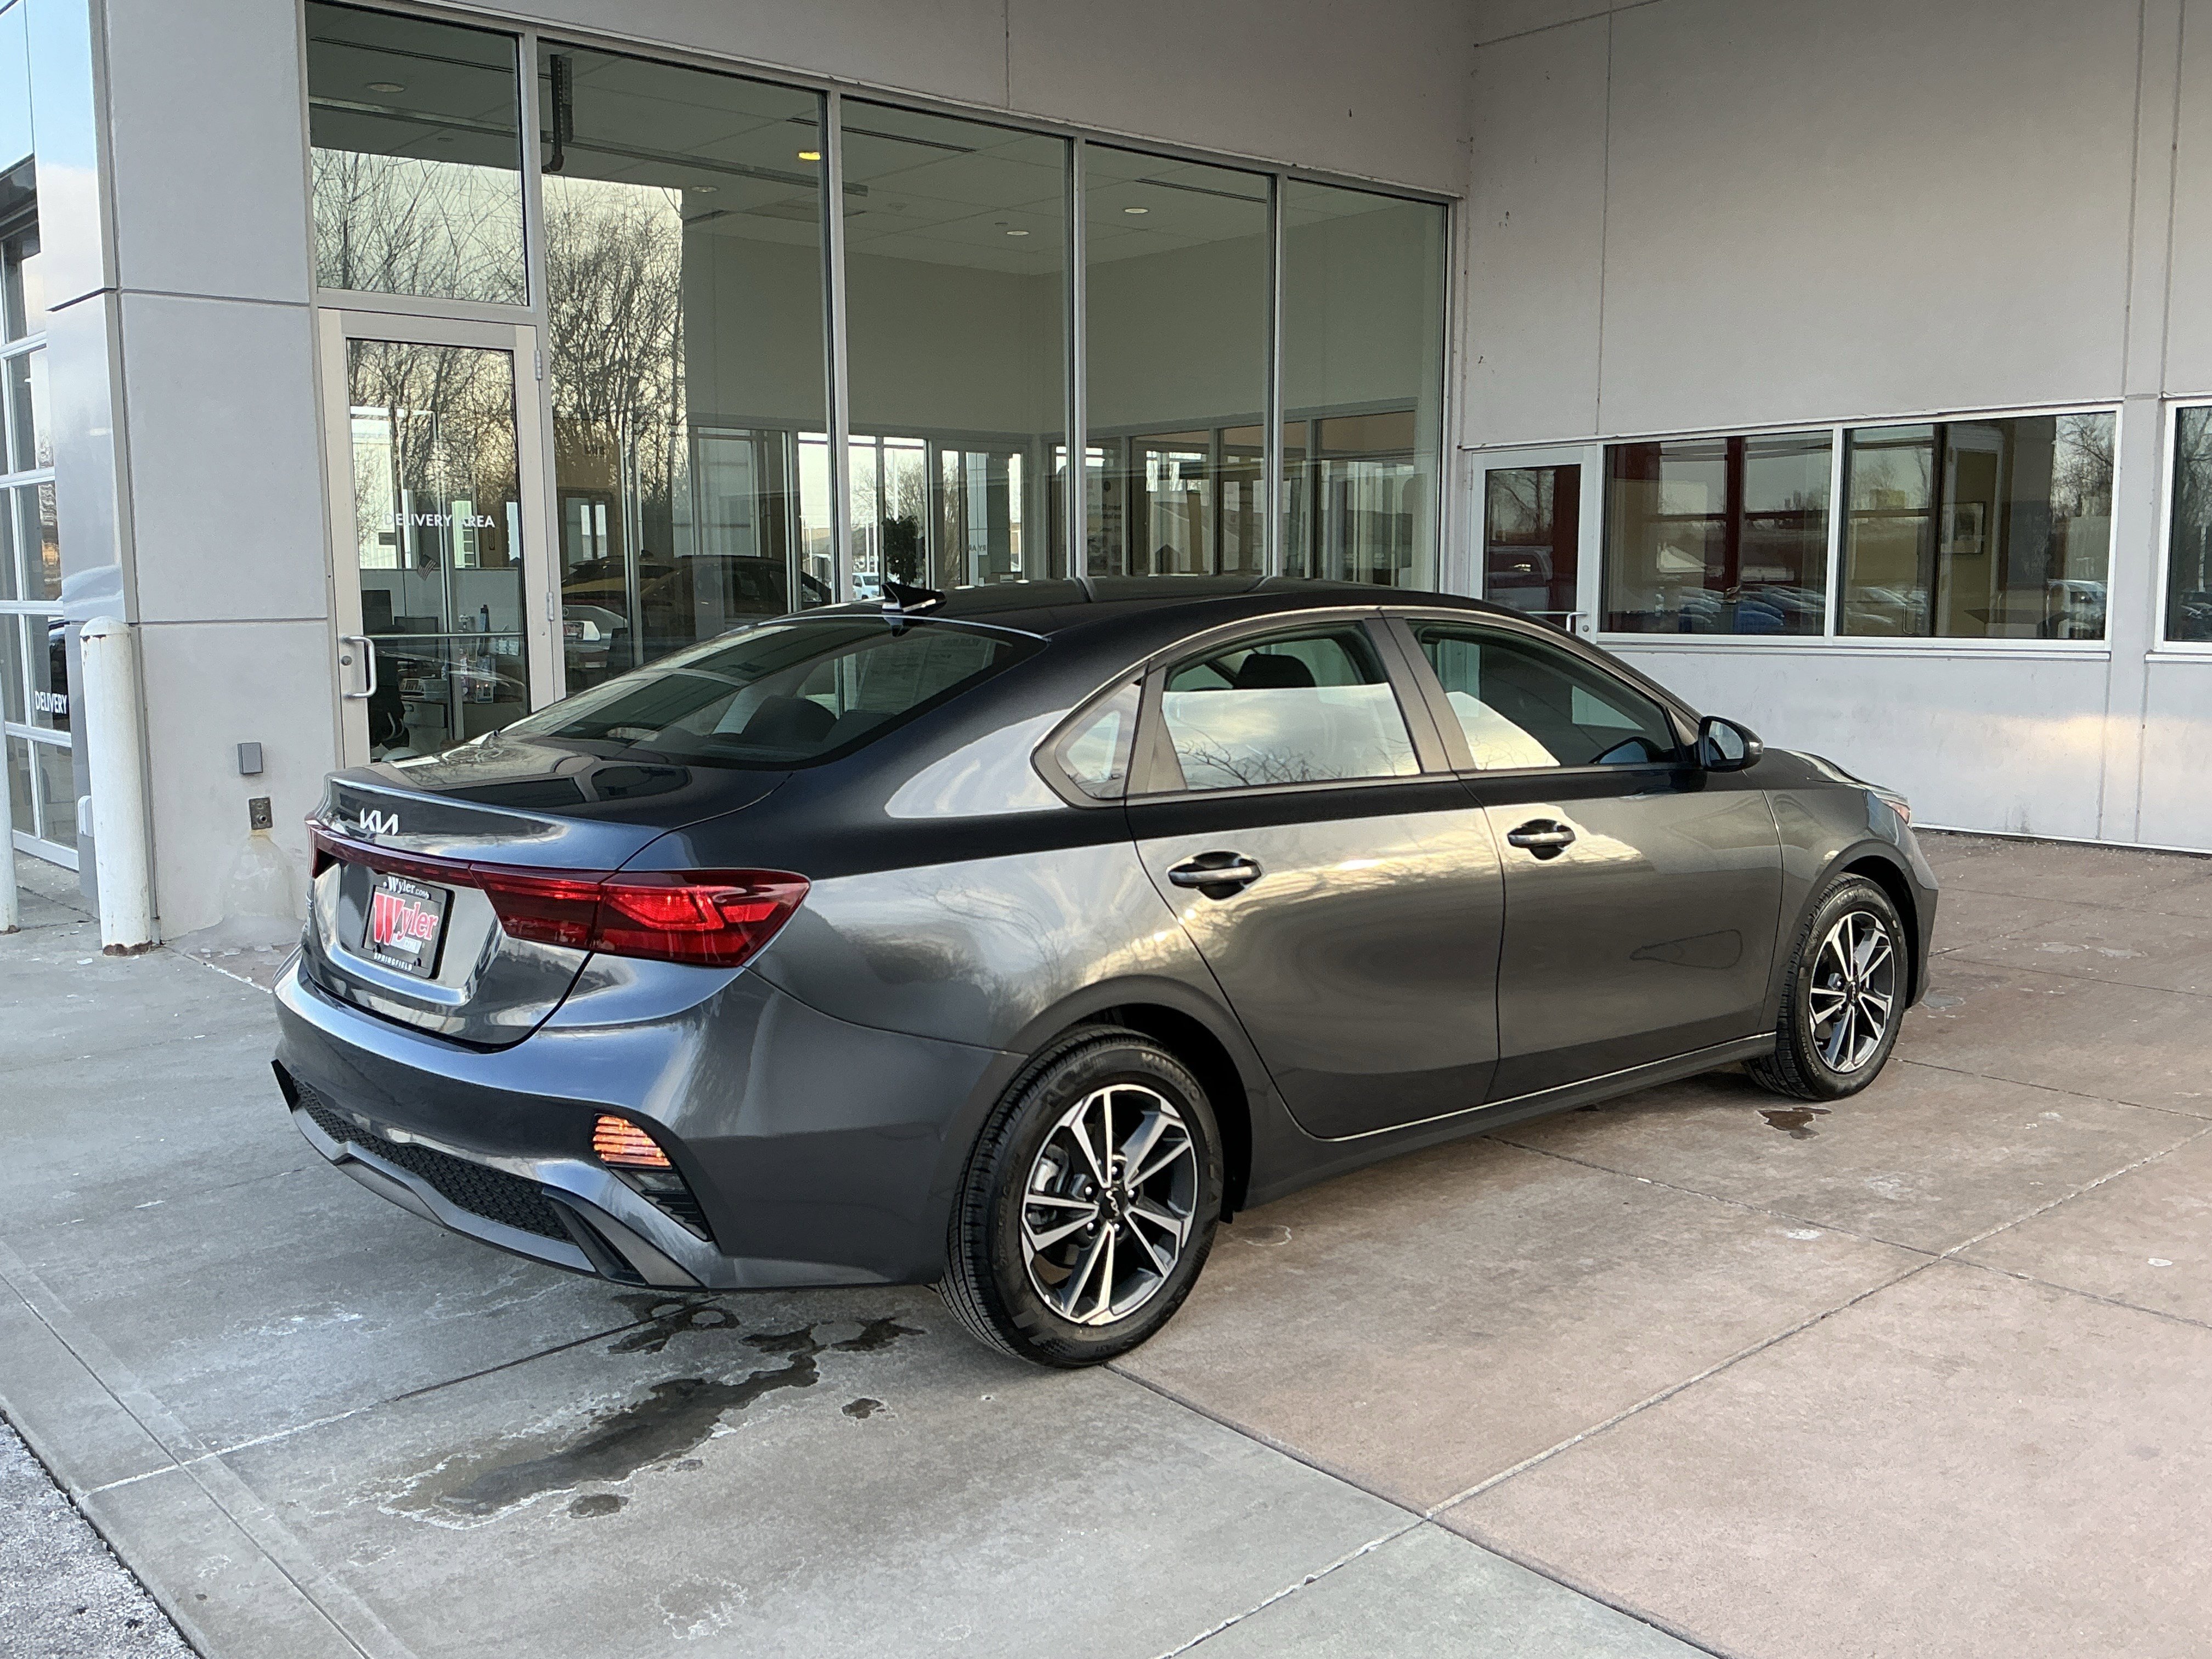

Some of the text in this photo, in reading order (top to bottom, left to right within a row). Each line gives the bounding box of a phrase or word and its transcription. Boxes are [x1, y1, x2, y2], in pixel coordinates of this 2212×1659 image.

[385, 514, 496, 528] DELIVERY AREA
[35, 691, 67, 714] DELIVERY
[374, 892, 438, 945] Wyler
[374, 952, 413, 972] SPRINGFIELD
